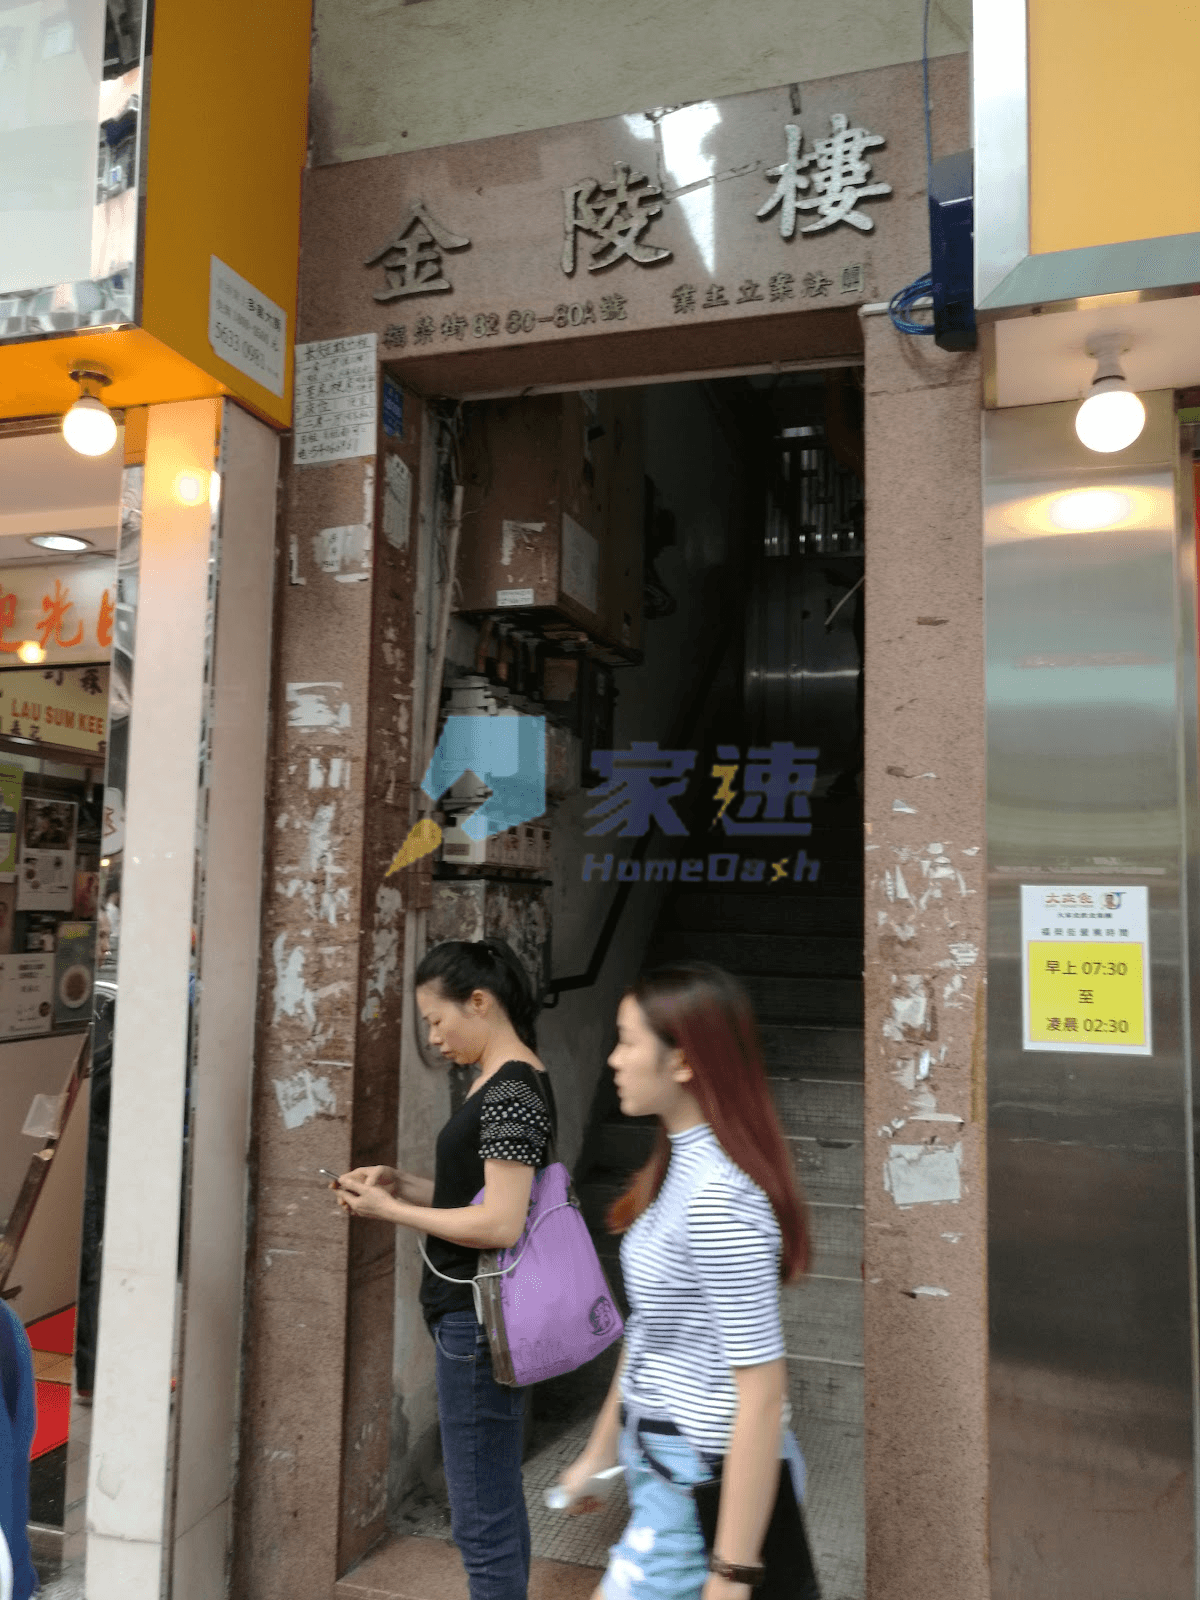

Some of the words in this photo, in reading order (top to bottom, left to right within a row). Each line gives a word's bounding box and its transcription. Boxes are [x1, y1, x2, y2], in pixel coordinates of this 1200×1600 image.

[364, 112, 893, 303] 金陵樓
[79, 713, 104, 735] KEE
[1045, 960, 1078, 975] 早上
[1081, 961, 1129, 976] 07:30
[1078, 989, 1095, 1004] 至
[1046, 1017, 1079, 1032] 凌晨
[1083, 1018, 1130, 1034] 02:30
